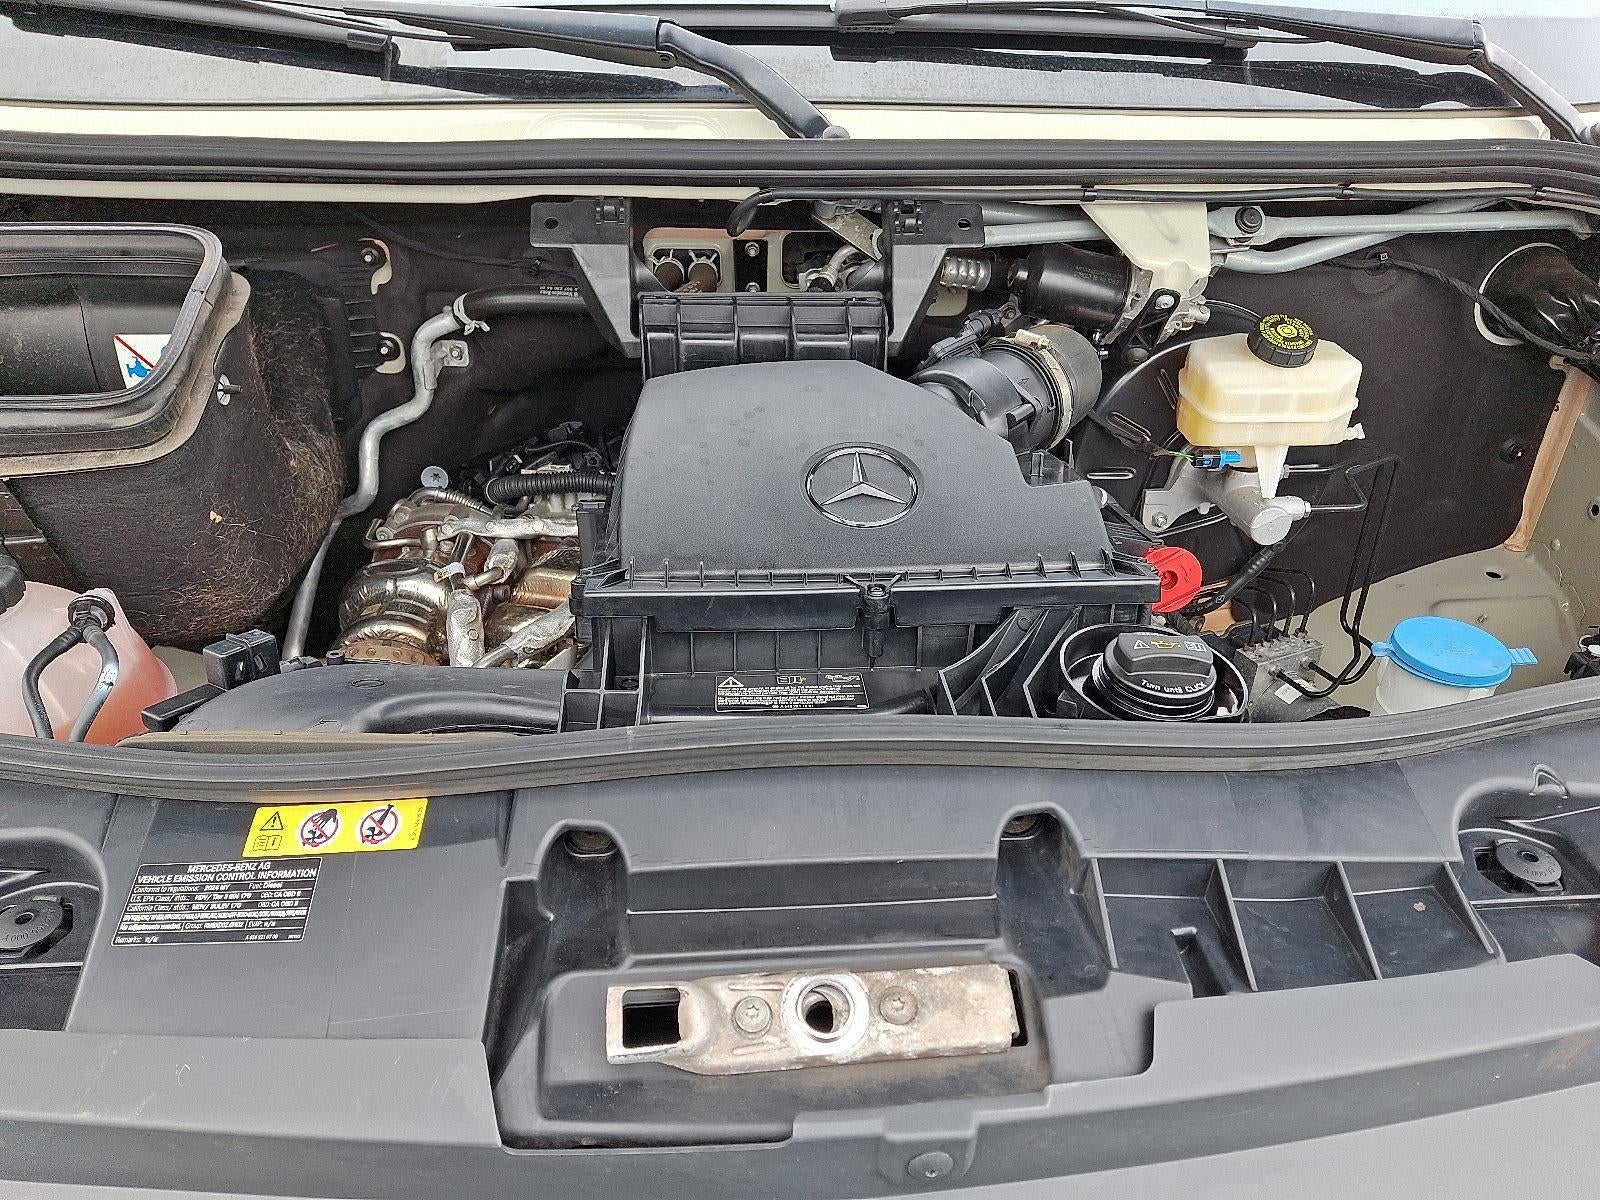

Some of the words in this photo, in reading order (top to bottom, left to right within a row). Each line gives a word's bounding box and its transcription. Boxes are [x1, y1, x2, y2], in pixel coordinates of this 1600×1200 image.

[1141, 679, 1161, 691] Turn
[1163, 686, 1183, 694] until
[1185, 681, 1207, 693] CLICK
[187, 862, 259, 873] MERCEDES-BENZ
[257, 861, 271, 870] AG
[137, 874, 173, 884] VEHICLE
[172, 873, 216, 882] EMISSION
[215, 872, 256, 881] CONTROL
[257, 868, 318, 879] INFORMATION
[133, 885, 161, 893] Conforms
[160, 885, 167, 893] to
[203, 884, 220, 892] 2024
[219, 883, 231, 891] MY
[263, 881, 284, 889] Diesel
[130, 895, 142, 903] U.S.
[142, 895, 155, 903] EPA
[240, 892, 253, 900] 170
[126, 903, 154, 912] California
[115, 936, 143, 944] Remarks:
[144, 935, 159, 943] n/a
